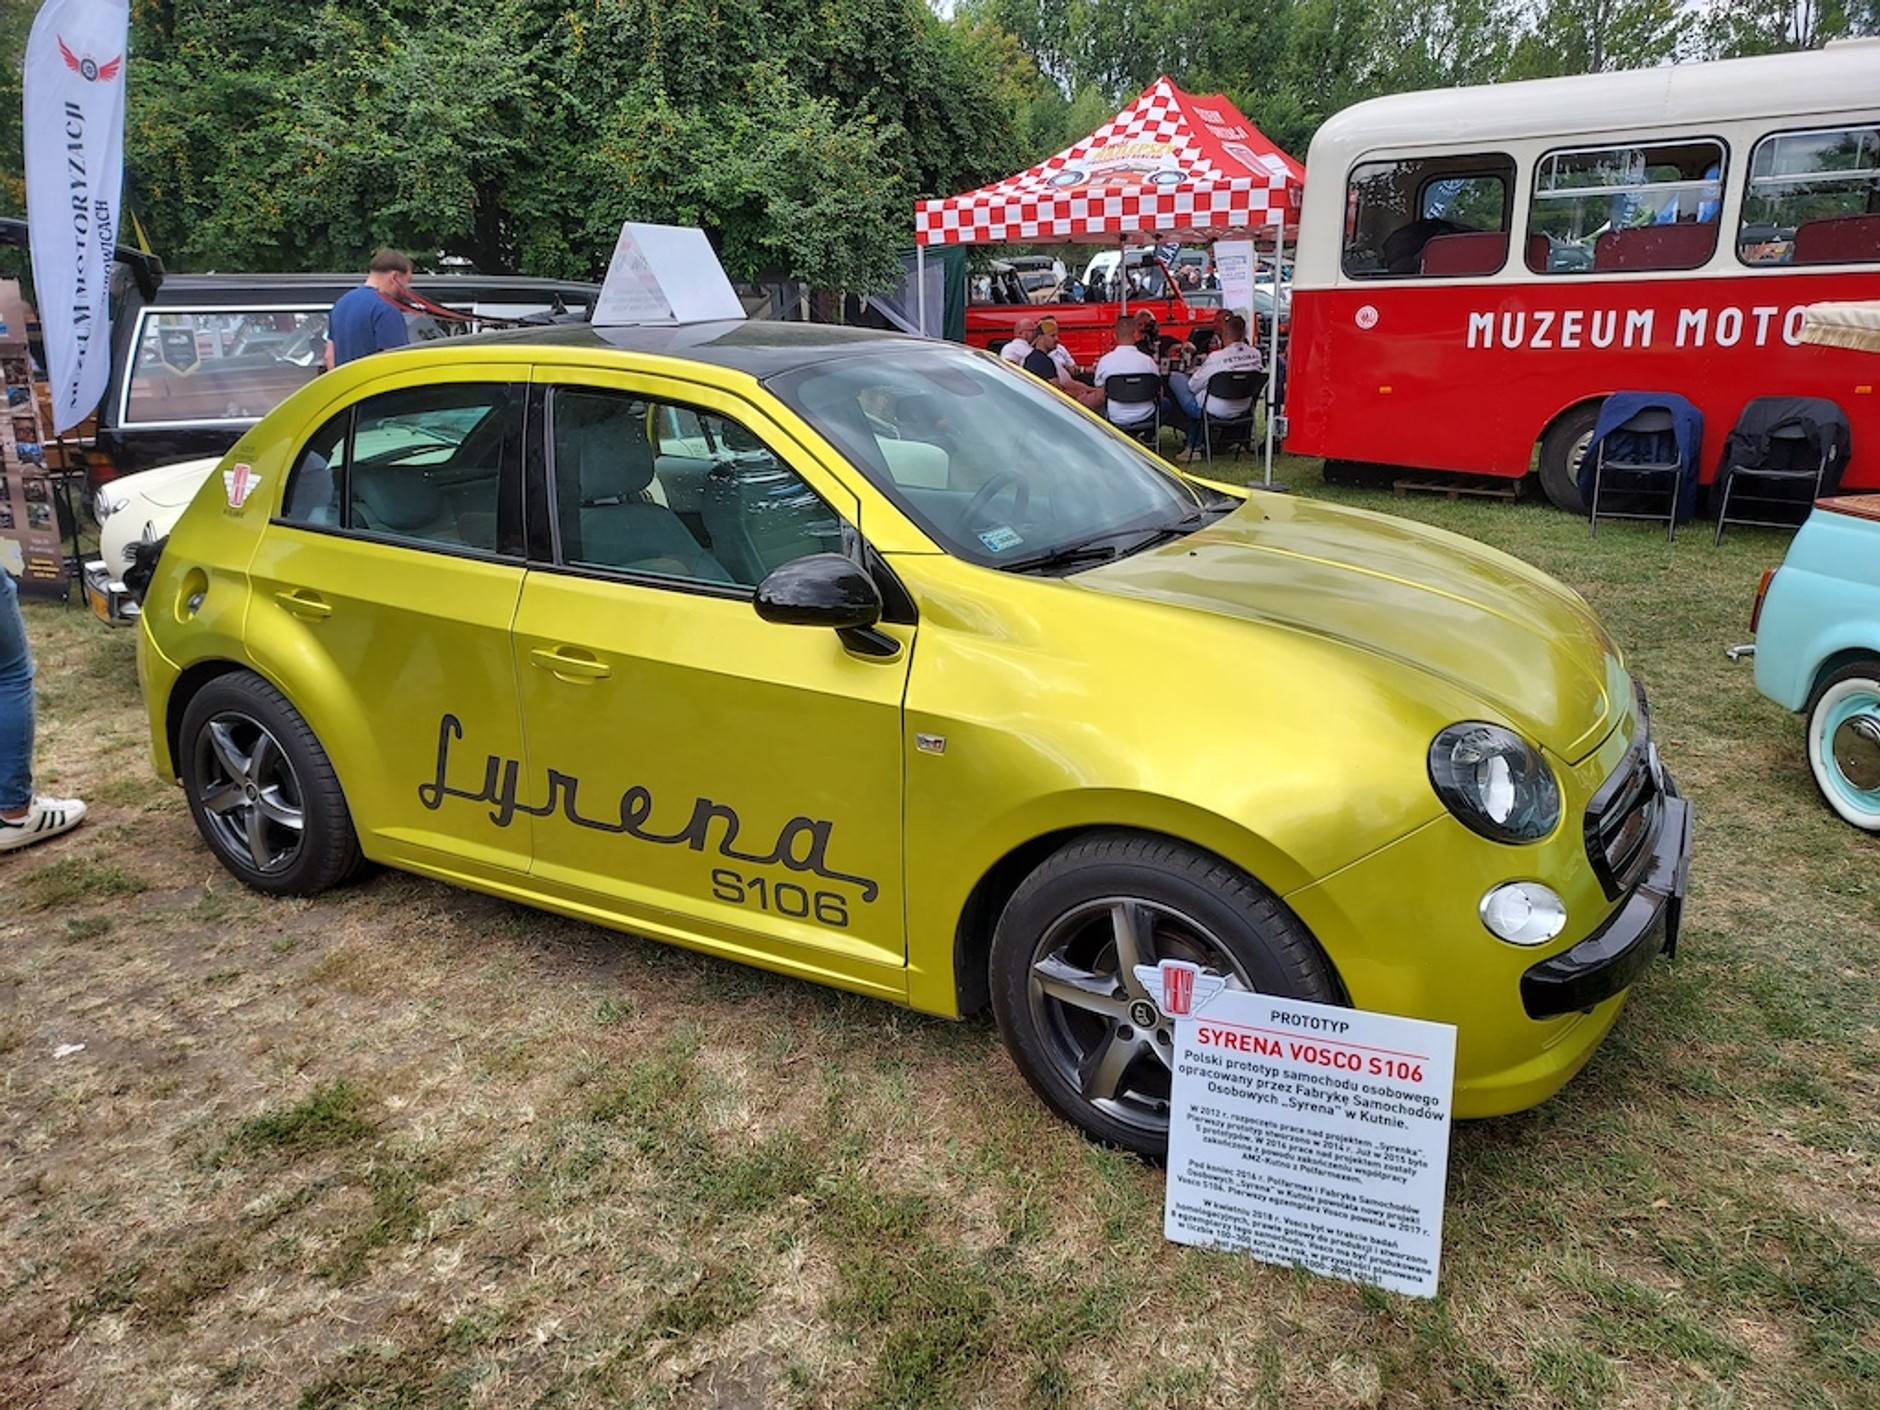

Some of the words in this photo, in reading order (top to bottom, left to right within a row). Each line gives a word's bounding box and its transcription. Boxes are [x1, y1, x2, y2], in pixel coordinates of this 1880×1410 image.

[1467, 309, 1656, 349] MUZEUM
[711, 867, 849, 928] S106
[1270, 1009, 1350, 1034] PROTOTYP
[1198, 1027, 1283, 1058] SYRENA
[1289, 1042, 1362, 1072] VOSCO
[1368, 1057, 1423, 1083] S106
[1178, 1064, 1254, 1089] opracowany
[1256, 1078, 1293, 1094] przez
[1295, 1083, 1350, 1107] Fabrykę
[1352, 1094, 1445, 1122] Samochodów
[1184, 1049, 1223, 1067] Polski
[1225, 1059, 1280, 1079] prototyp
[1282, 1069, 1359, 1092] samochodu
[1361, 1084, 1440, 1107] osobowego
[1200, 1106, 1221, 1118] 2012
[1279, 1123, 1305, 1134] prace
[1306, 1128, 1324, 1138] nad
[1325, 1132, 1373, 1148] projektem
[1207, 1081, 1279, 1105] Osobowych
[1344, 1109, 1357, 1120] w
[1360, 1110, 1409, 1130] Kutnie.
[1186, 1112, 1225, 1129] Pierwszy
[1226, 1122, 1263, 1137] prototyp
[1264, 1130, 1311, 1145] stworzono
[1322, 1139, 1345, 1152] 2014
[1261, 1147, 1296, 1161] powodu
[1241, 1152, 1291, 1169] AMZ-Kutno
[1288, 1144, 1314, 1155] prace
[1315, 1149, 1333, 1159] nad
[1334, 1153, 1382, 1169] projektem
[1176, 1174, 1201, 1187] Vosco
[1228, 1186, 1267, 1202] Pierwszy
[1322, 1206, 1349, 1219] Vosco
[1187, 1167, 1234, 1184] Osobowych
[1286, 1189, 1316, 1203] Kutnie
[1360, 1206, 1385, 1218] nowy
[1386, 1212, 1421, 1225] projekt
[1188, 1158, 1205, 1170] Pod
[1320, 1187, 1357, 1202] Fabryka
